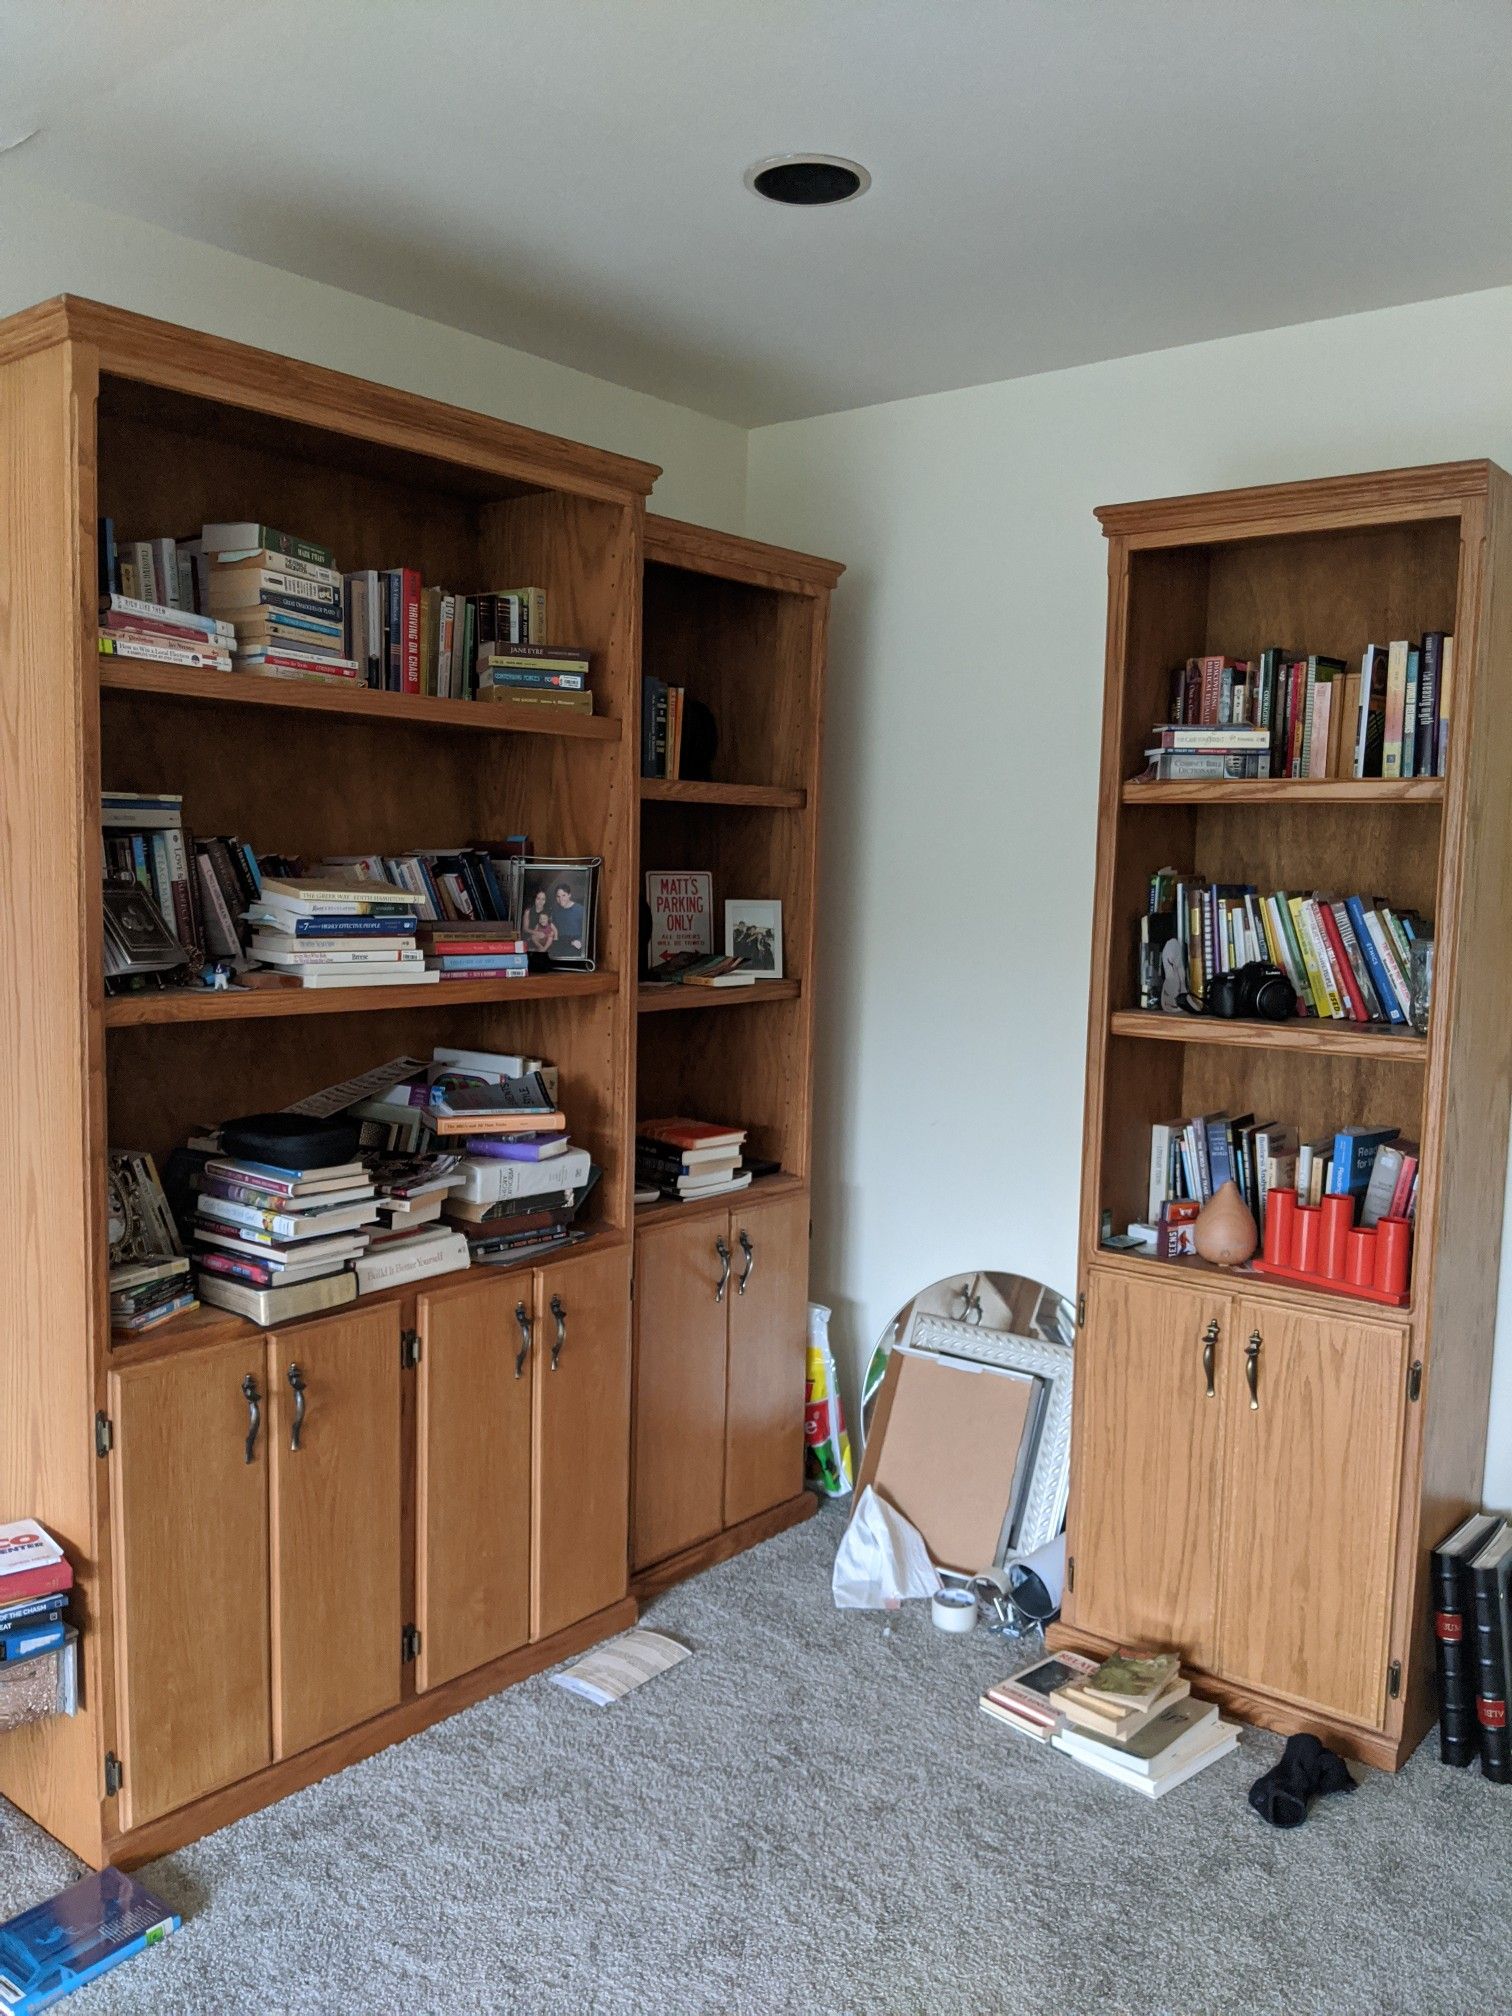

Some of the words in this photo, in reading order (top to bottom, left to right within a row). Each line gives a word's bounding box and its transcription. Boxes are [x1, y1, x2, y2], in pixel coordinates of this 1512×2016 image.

[408, 602, 418, 643] THRIVING
[408, 643, 418, 655] ON
[510, 646, 528, 655] JANE
[528, 647, 544, 656] EYRE
[408, 655, 418, 683] CHAOS
[1211, 660, 1219, 710] DISCOVERING
[1407, 681, 1417, 703] WORLD
[1419, 681, 1434, 709] beauty
[1417, 708, 1433, 726] myth
[660, 877, 698, 895] MATT'S
[656, 896, 704, 913] PARKING
[666, 914, 694, 931] ONLY
[1328, 992, 1340, 1012] USED
[1197, 1150, 1205, 1168] WORLD
[1257, 1136, 1267, 1167] Business
[416, 1251, 444, 1268] Yourself
[9, 1609, 22, 1619] THE
[23, 1604, 47, 1615] CHASM
